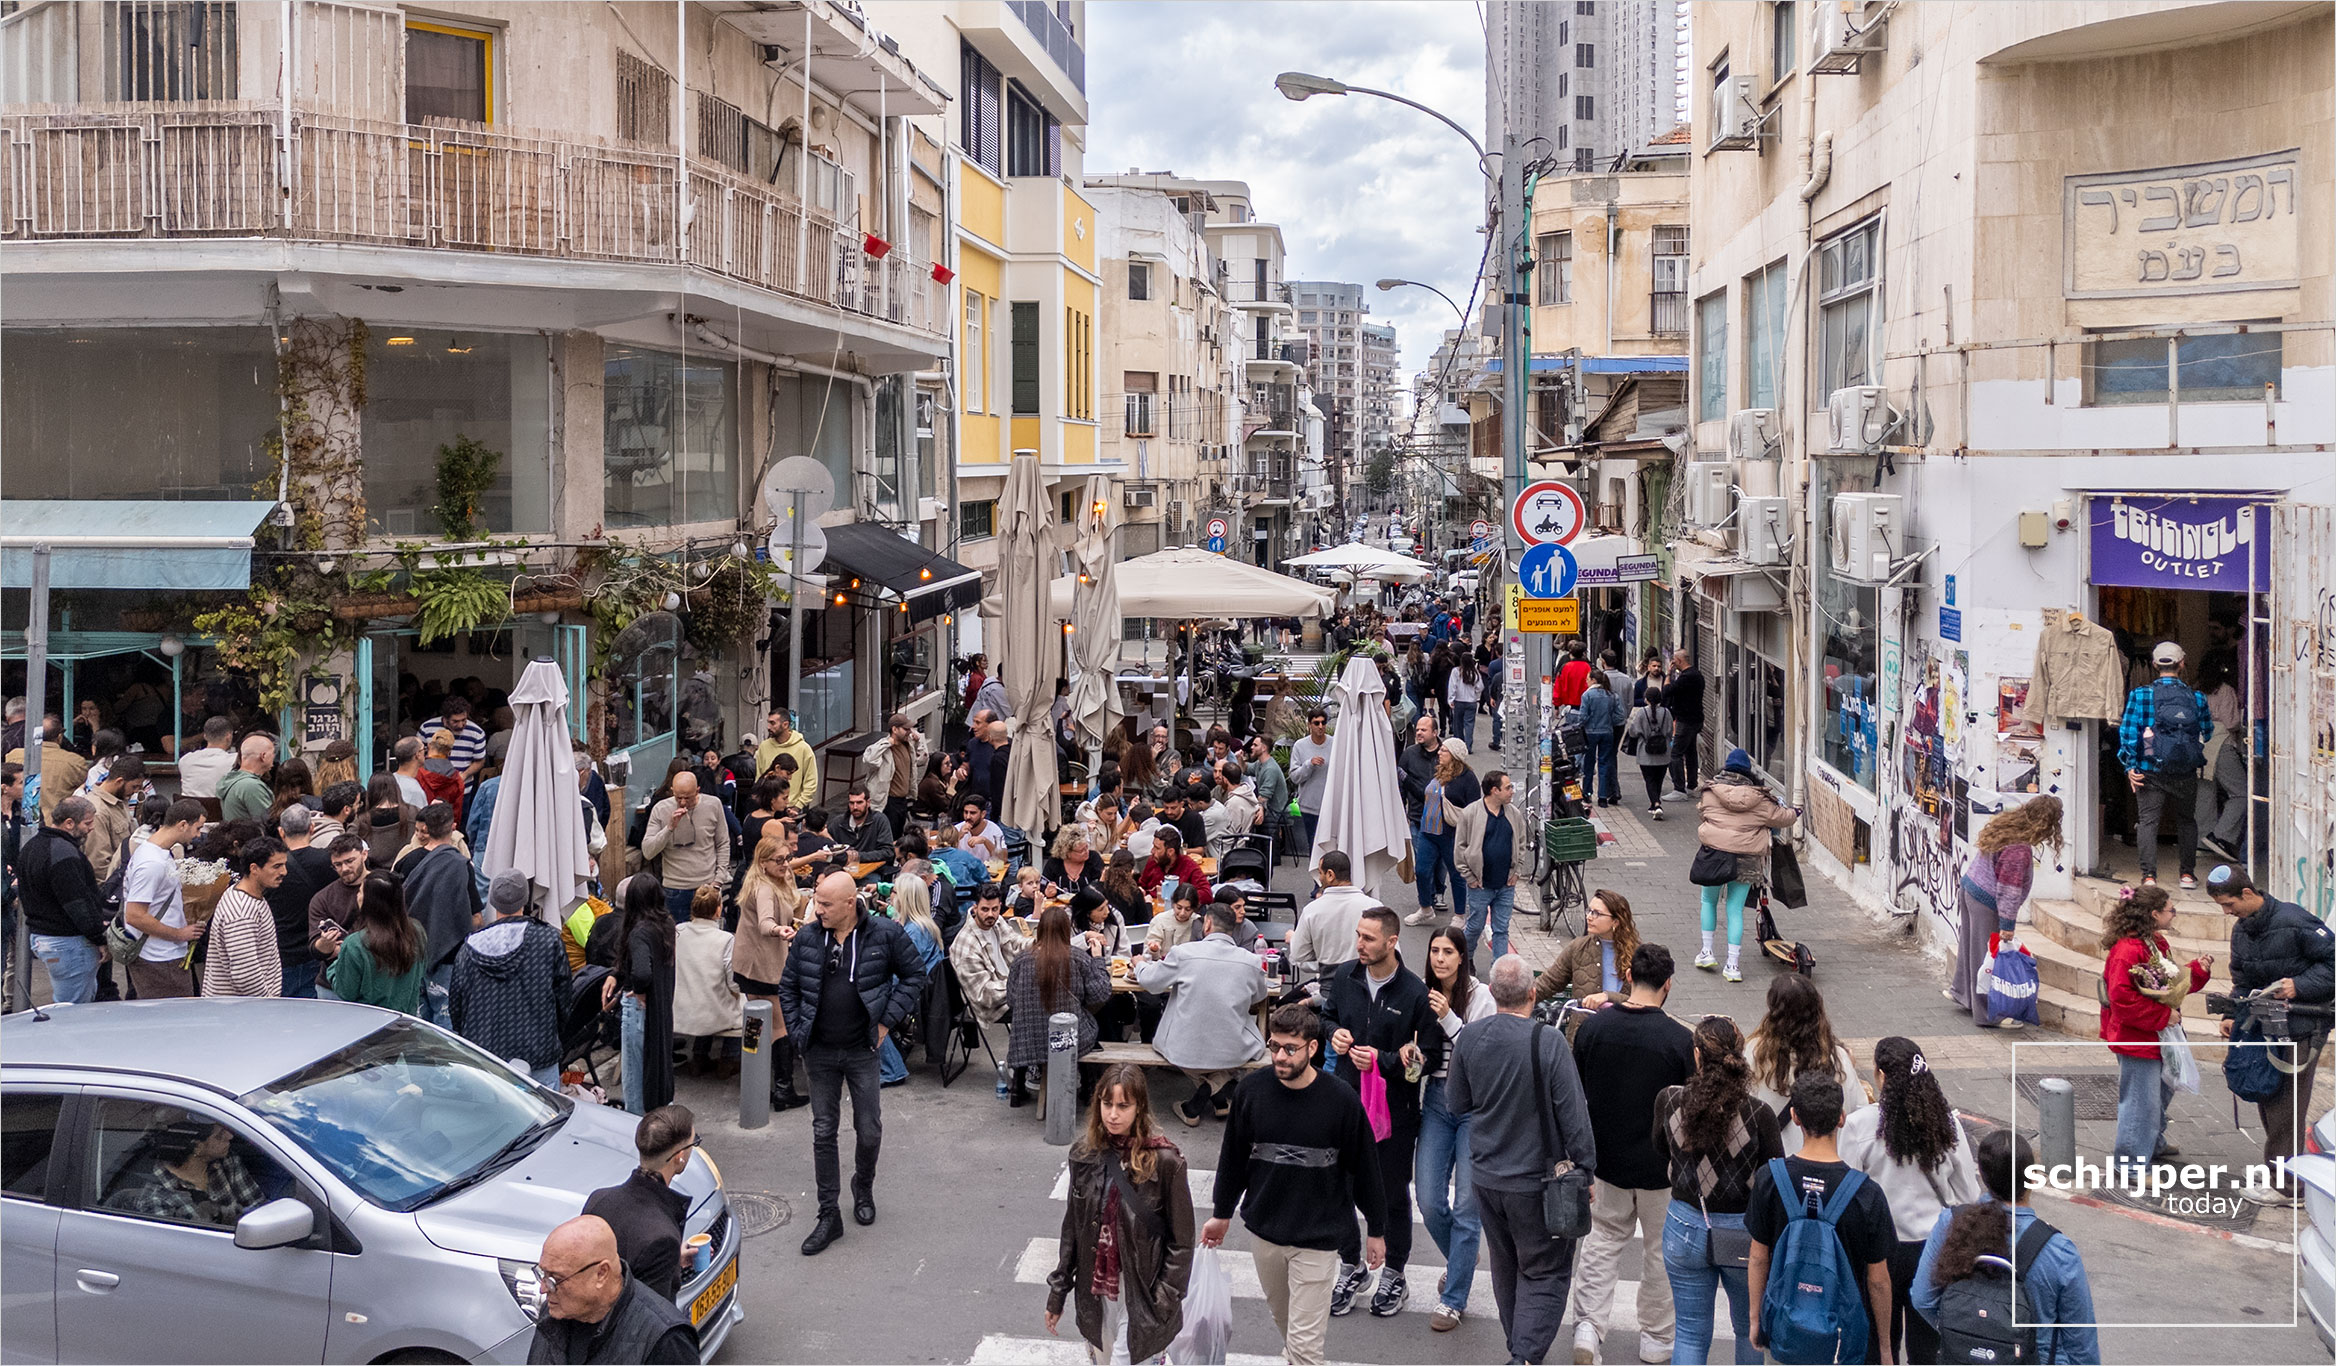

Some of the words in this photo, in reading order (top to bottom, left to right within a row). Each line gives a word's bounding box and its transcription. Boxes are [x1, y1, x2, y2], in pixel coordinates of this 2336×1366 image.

[2081, 168, 2294, 234] המשביר
[2141, 551, 2224, 579] OUTLET
[1553, 605, 1575, 613] למעט
[1560, 618, 1571, 626] לא
[310, 714, 338, 723] גרגר
[308, 723, 340, 732] הזהב
